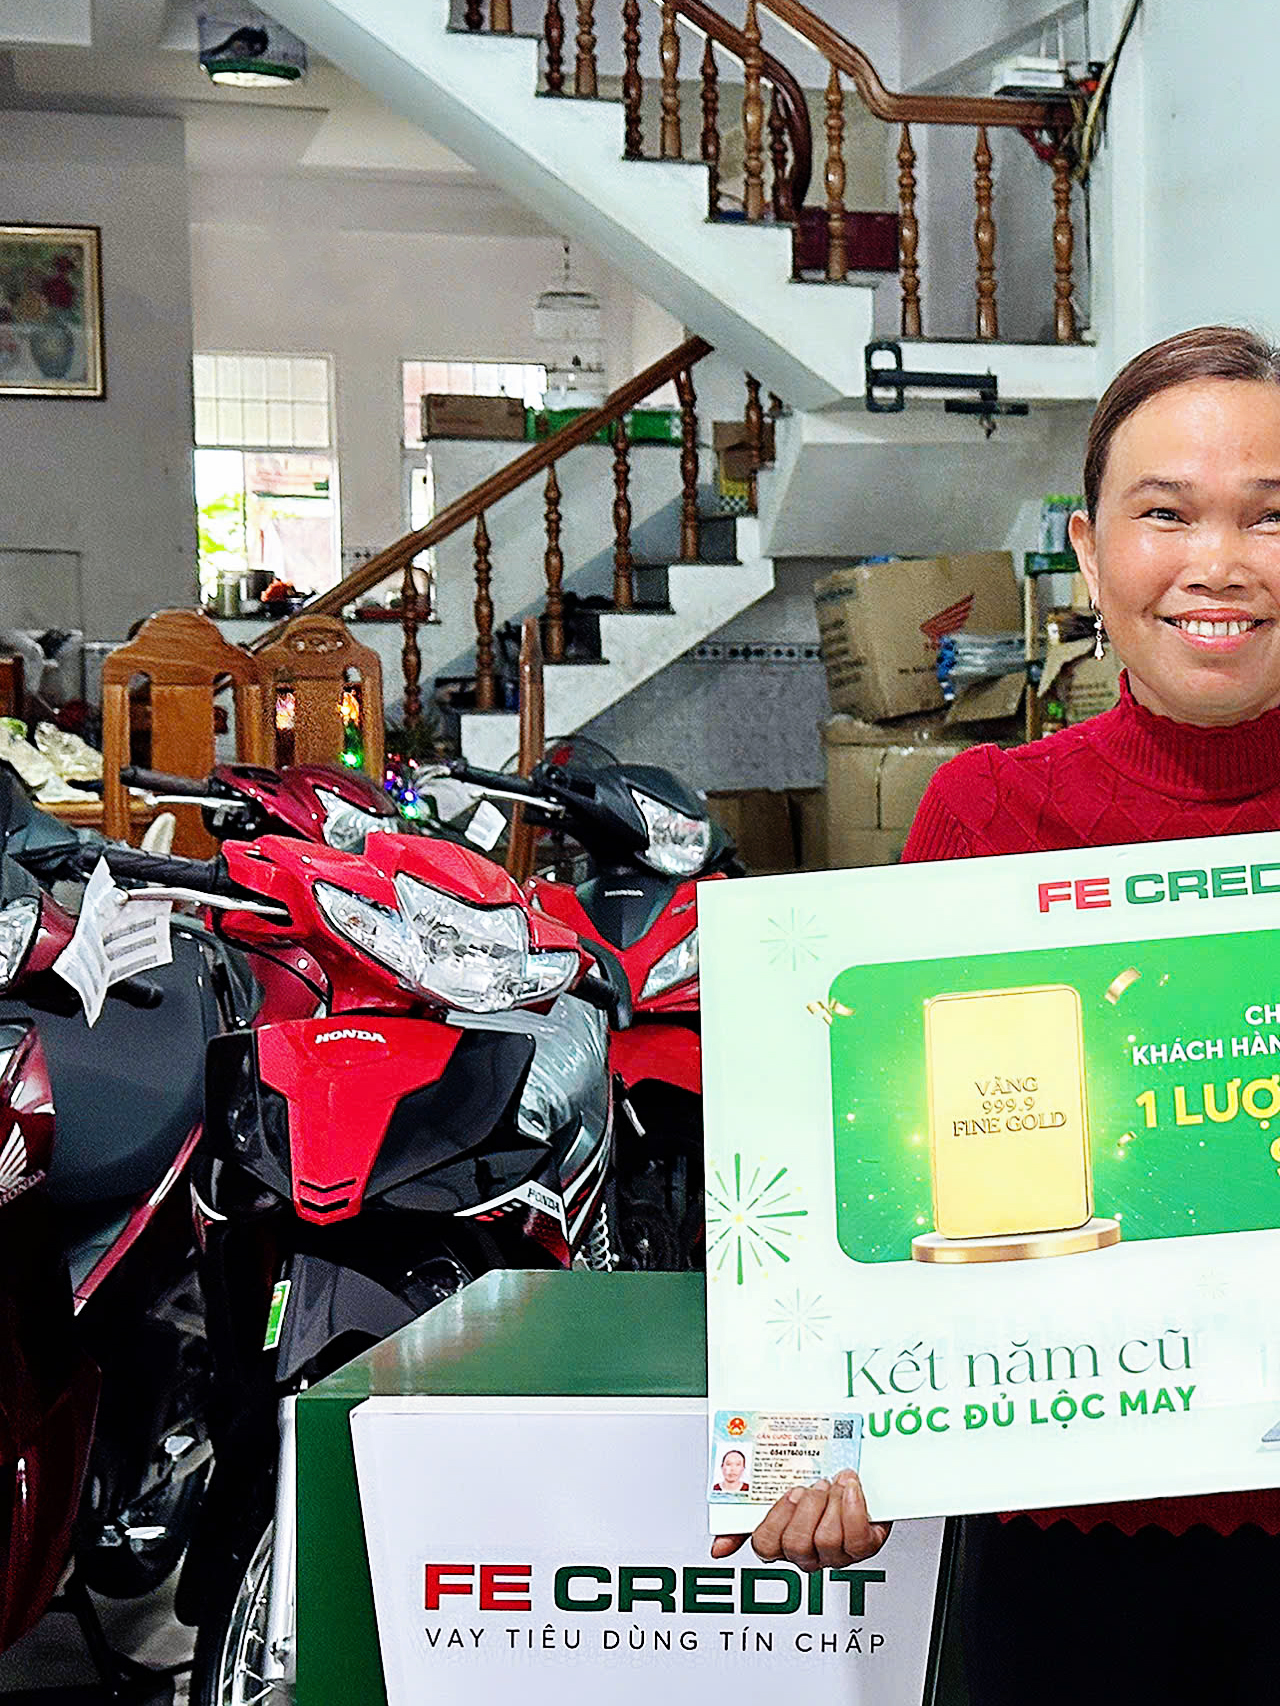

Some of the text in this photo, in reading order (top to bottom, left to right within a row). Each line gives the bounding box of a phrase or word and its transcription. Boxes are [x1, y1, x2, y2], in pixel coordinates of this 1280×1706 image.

[1038, 877, 1112, 913] FE
[315, 1028, 387, 1044] HONDA
[1132, 1037, 1224, 1066] KHÁCH
[975, 1076, 1038, 1096] VÀNG
[982, 1096, 1035, 1114] 999.9
[1135, 1091, 1157, 1128] 1
[953, 1112, 1067, 1136] FINE GOLD
[527, 1187, 560, 1213] HONDA
[845, 1329, 1193, 1398] Kết năm cũ
[861, 1402, 950, 1439] ƯỚC
[964, 1392, 1015, 1429] ĐỦ
[1030, 1389, 1106, 1430] LỘC
[1119, 1385, 1197, 1416] MAY
[424, 1563, 886, 1616] FE CREDIT
[425, 1623, 886, 1654] VAY TIÊU DÙNG TÍN CHẤP
